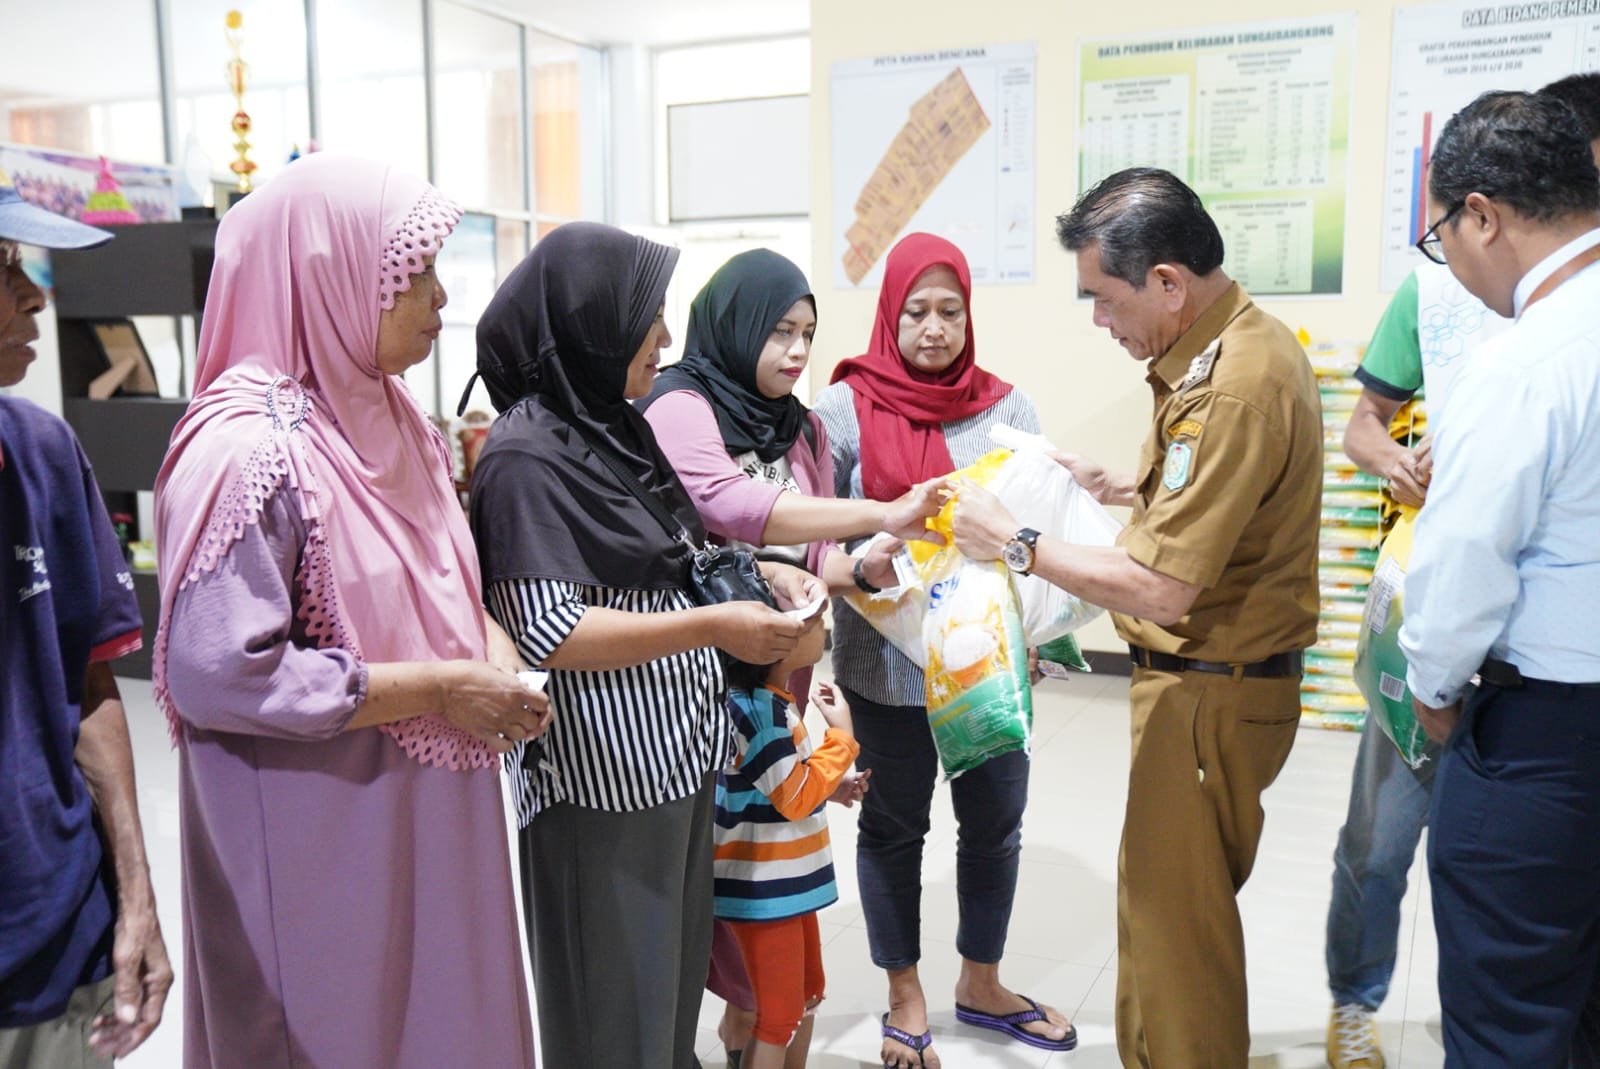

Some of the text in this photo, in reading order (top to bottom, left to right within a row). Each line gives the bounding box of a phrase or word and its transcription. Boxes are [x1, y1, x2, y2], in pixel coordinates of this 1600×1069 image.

[1462, 8, 1496, 28] DATA
[1497, 3, 1549, 24] BIDANG
[1098, 25, 1335, 57] DATA PENDUDUK KELURAHAN SUNGAIBANGKONG
[1419, 31, 1552, 53] GRAFIK PERKEMBANGAN PENDUDUK
[874, 47, 987, 66] PETA RAWAN BENCANA
[1426, 45, 1543, 65] KELURAHAN SUNGAIBANGKONG
